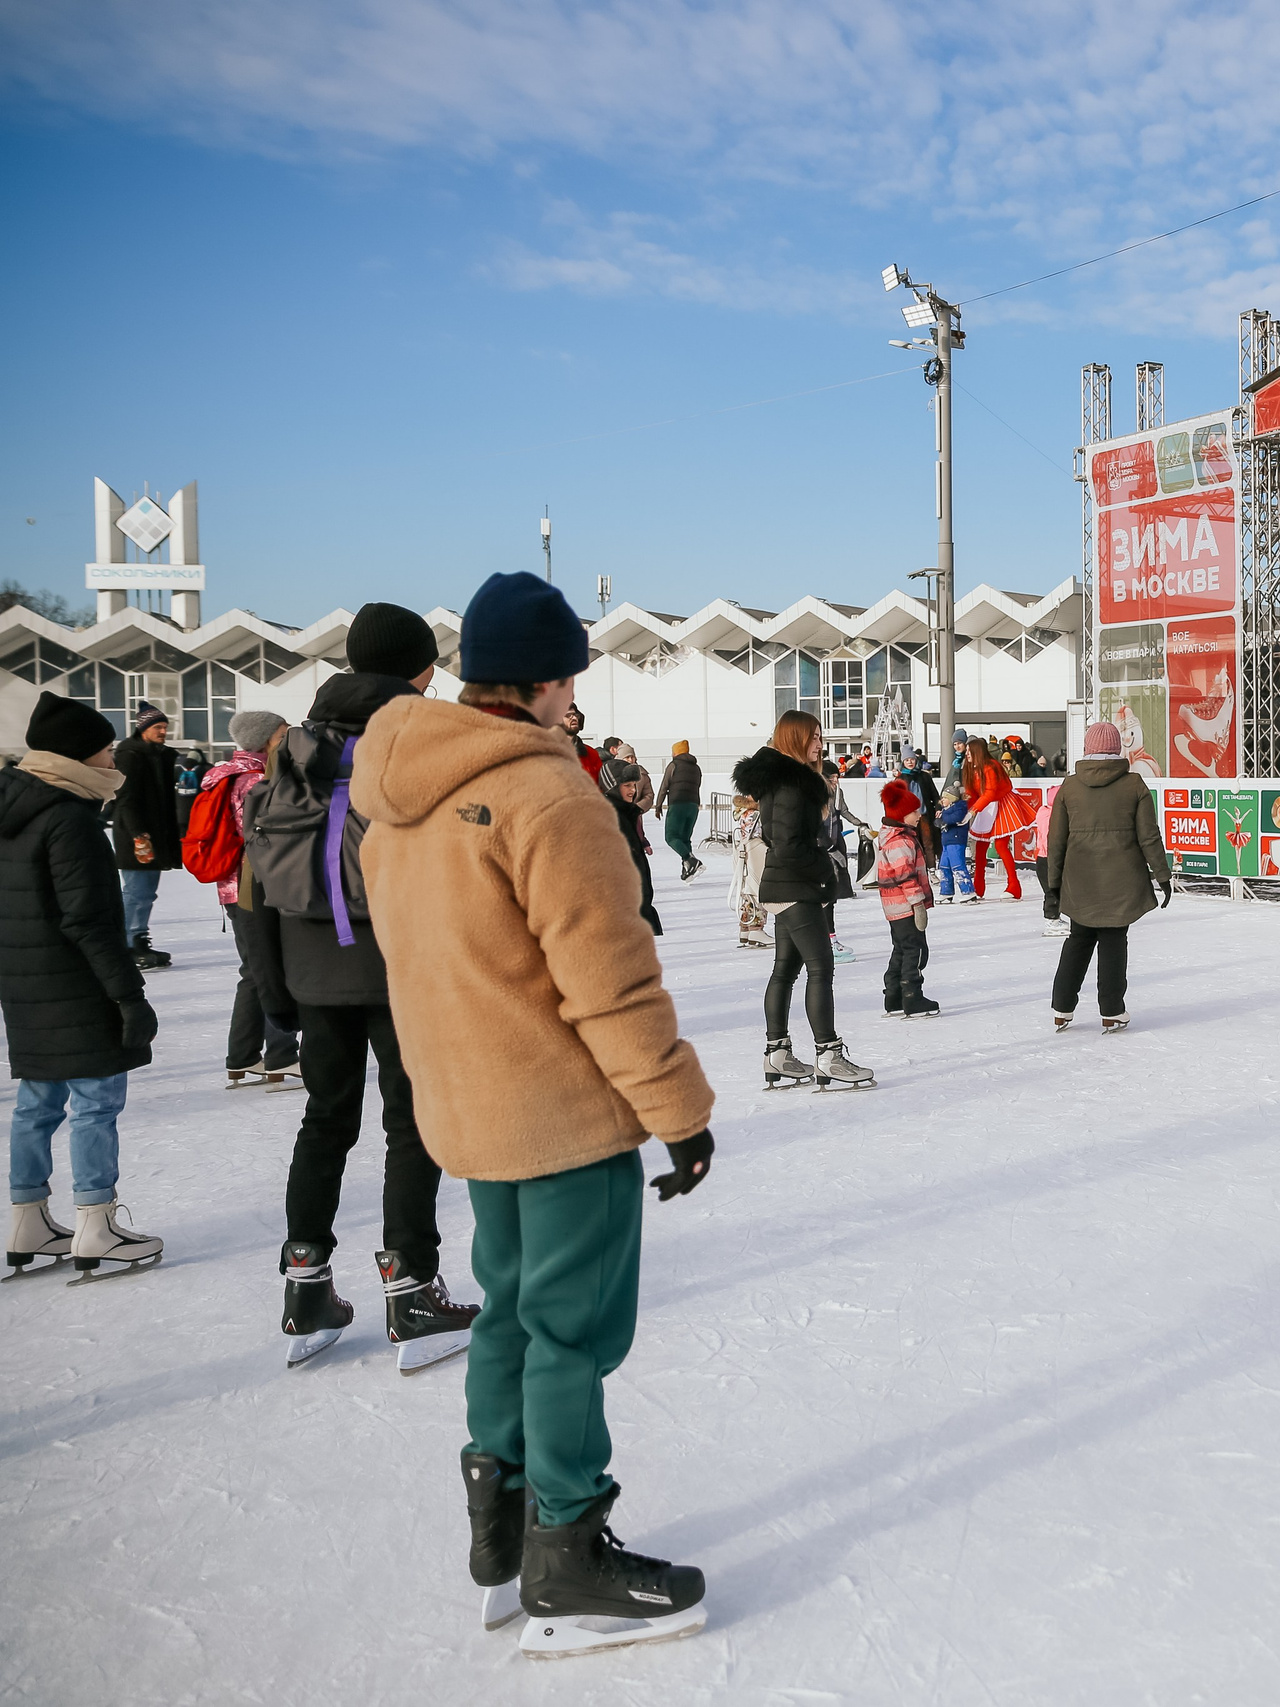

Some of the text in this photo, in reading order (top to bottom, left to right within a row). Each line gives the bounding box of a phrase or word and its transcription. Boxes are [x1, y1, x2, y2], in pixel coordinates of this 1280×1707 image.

[1111, 513, 1220, 572] ЗИМА
[91, 568, 201, 578] СОКОЛЬНИКИ
[1113, 565, 1220, 603] В МОСКВЕ
[1172, 631, 1190, 642] ВСЕ
[1107, 649, 1124, 660] ВСЕ
[1125, 649, 1132, 659] В
[1170, 817, 1210, 834] ЗИМА
[1171, 835, 1210, 845] В МОСКВЕ
[409, 1308, 434, 1317] RENTAL
[639, 1593, 664, 1602] NORDWAY
